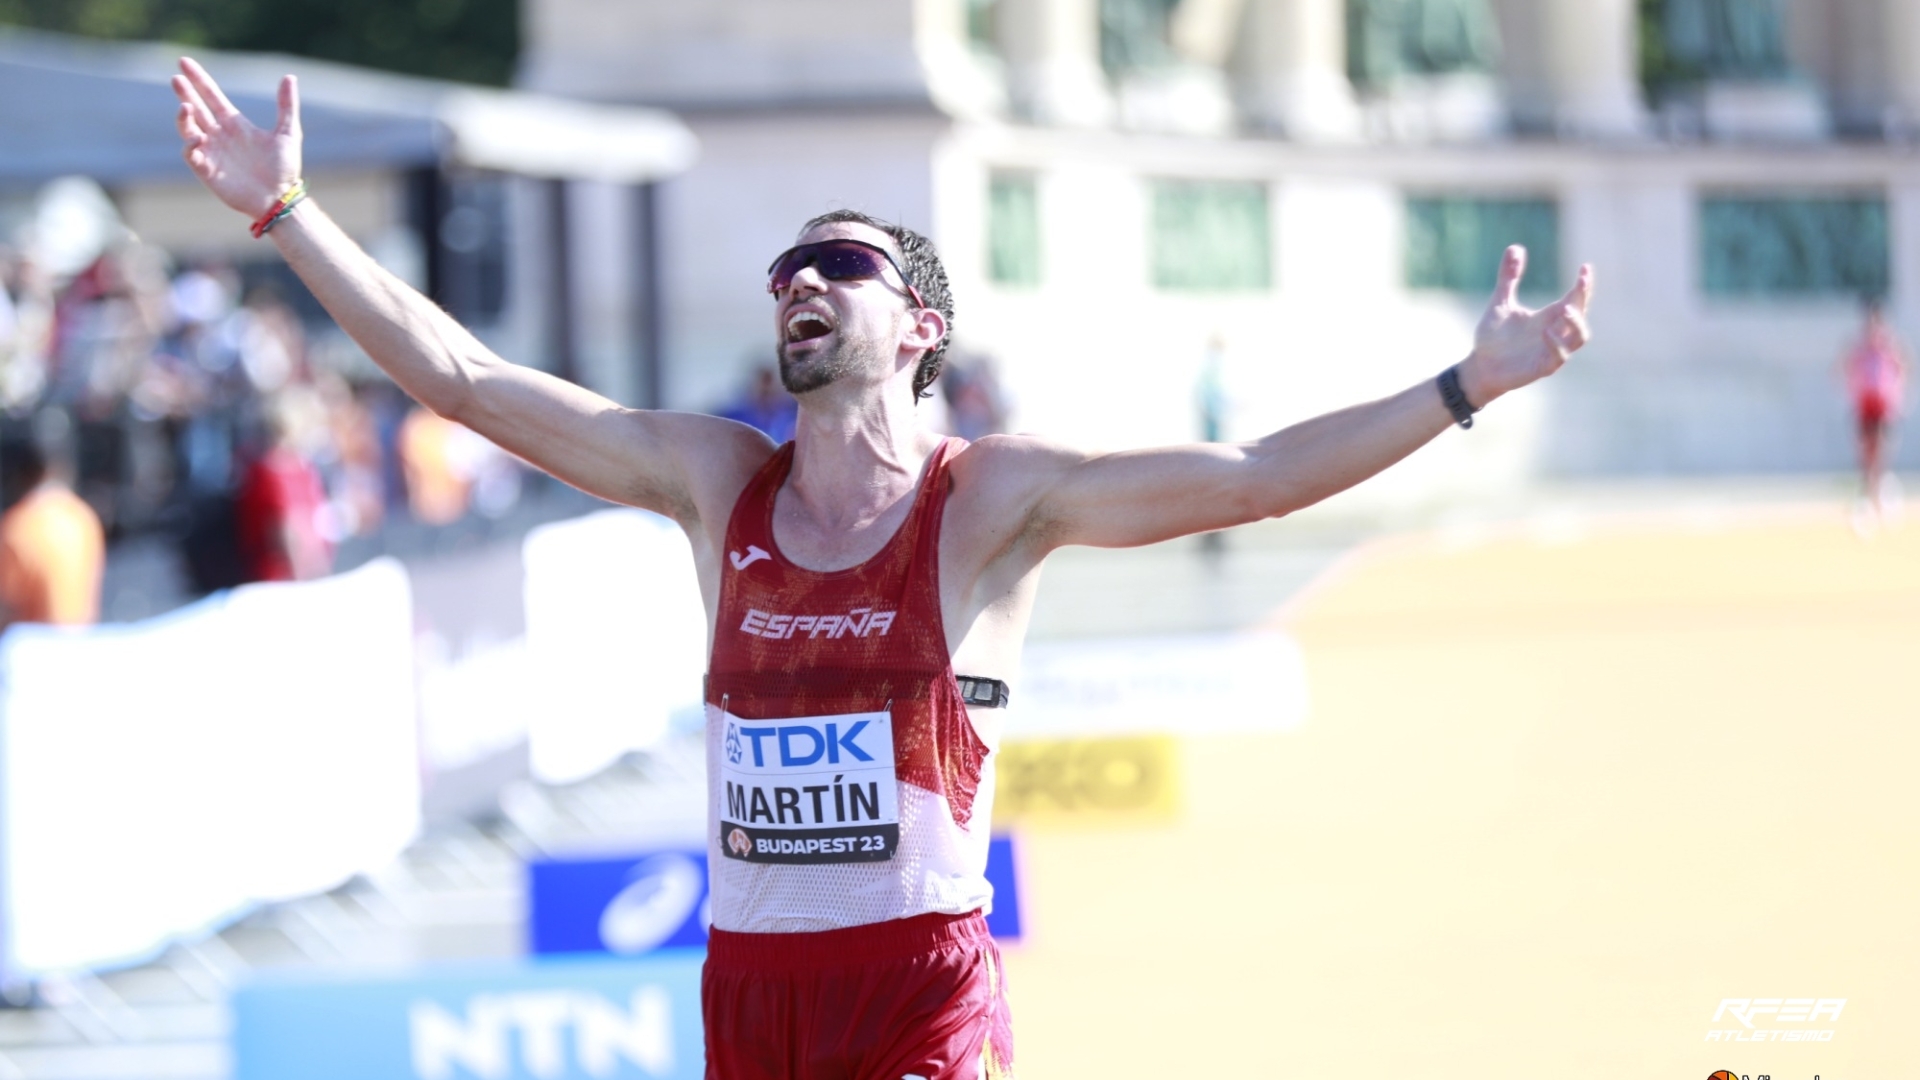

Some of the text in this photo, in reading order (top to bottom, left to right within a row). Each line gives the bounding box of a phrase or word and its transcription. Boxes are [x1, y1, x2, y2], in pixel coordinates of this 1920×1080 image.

[740, 608, 896, 639] ESPAÑA
[740, 721, 875, 767] TDK
[727, 775, 880, 823] MARTÍN
[756, 835, 885, 854] BUDAPEST 23
[409, 987, 673, 1078] NTN
